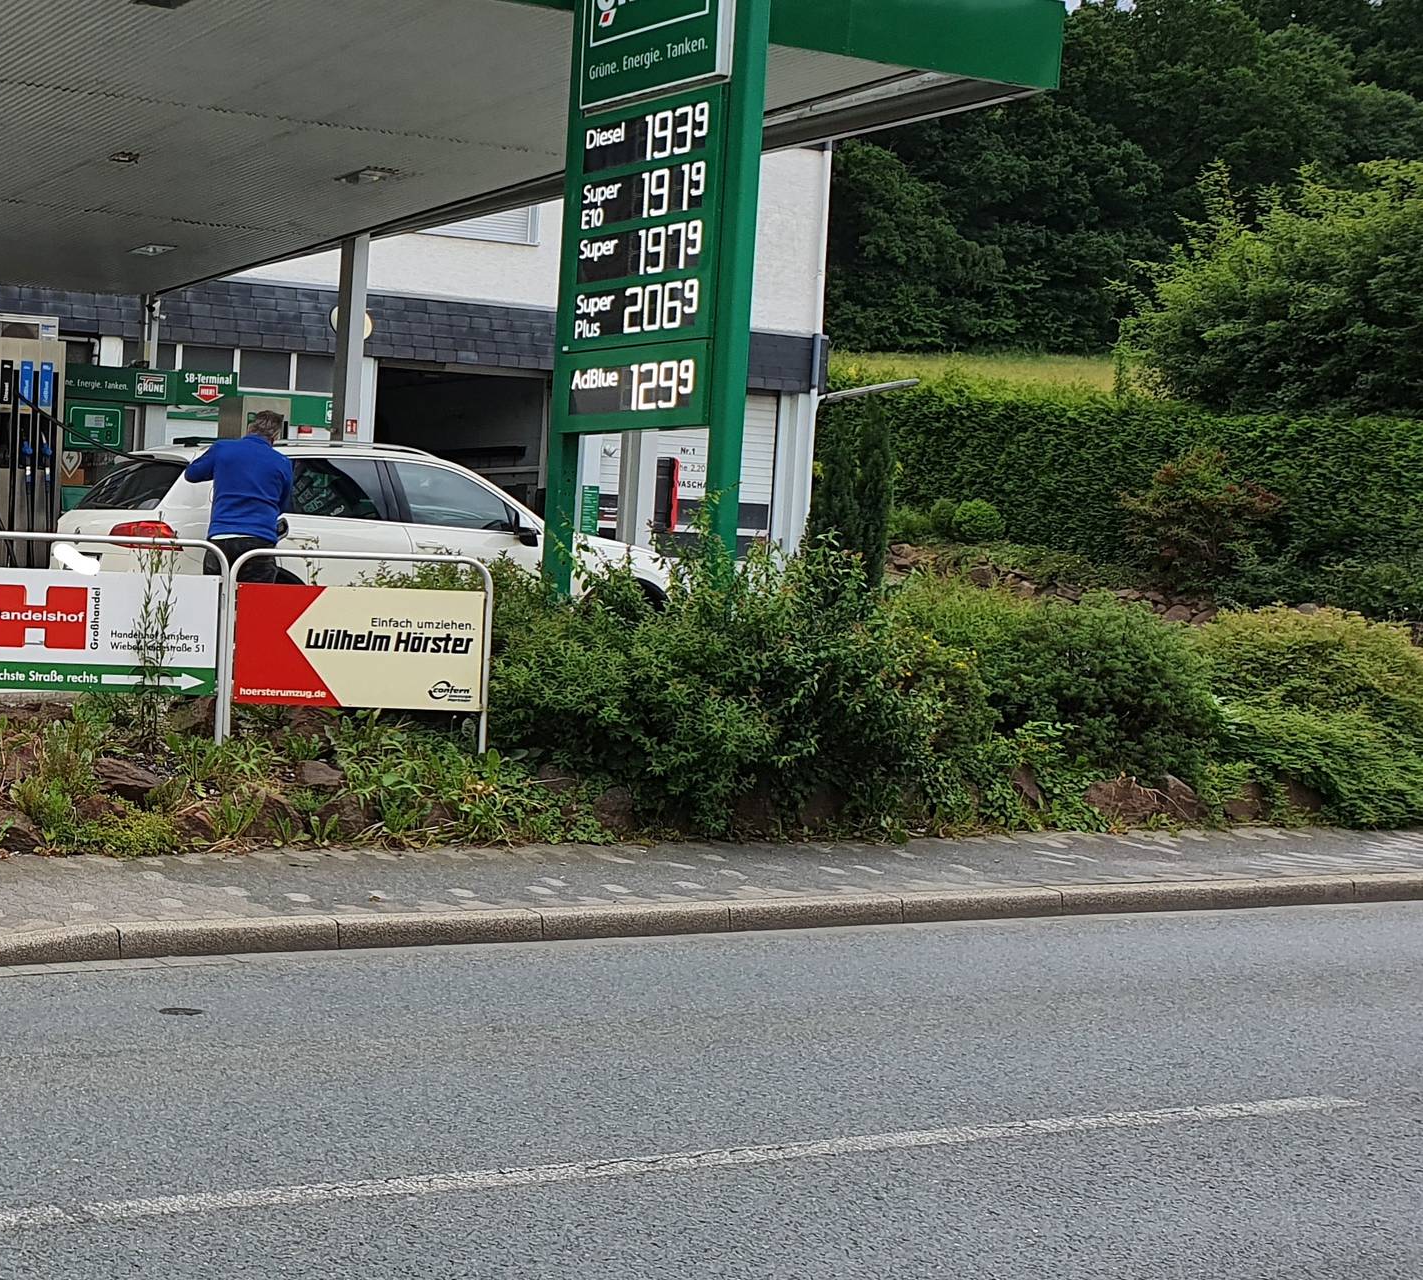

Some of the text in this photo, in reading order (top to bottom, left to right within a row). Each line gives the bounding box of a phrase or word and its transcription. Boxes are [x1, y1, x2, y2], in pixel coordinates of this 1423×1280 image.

[589, 37, 708, 80] Grüne. Energie. Tanken.
[585, 121, 625, 149] Diesel
[582, 183, 622, 205] Super
[580, 207, 604, 230] E10
[578, 239, 618, 261] Super
[575, 294, 615, 317] Super
[574, 319, 601, 339] Plus
[77, 379, 102, 390] Energie.
[105, 380, 129, 391] Tanken.
[137, 381, 165, 394] GRÜNE
[184, 372, 233, 385] SB-Terminal
[571, 368, 619, 390] AdBlue
[680, 447, 696, 455] Nr.1
[90, 587, 101, 650] Großhandel
[370, 617, 476, 631] Einfach umziehen.
[195, 644, 205, 652] 51
[305, 628, 474, 654] Wilhelm Hörster
[28, 669, 64, 684] Straße
[66, 672, 99, 684] rechts
[239, 687, 327, 699] hoersterumzug.de
